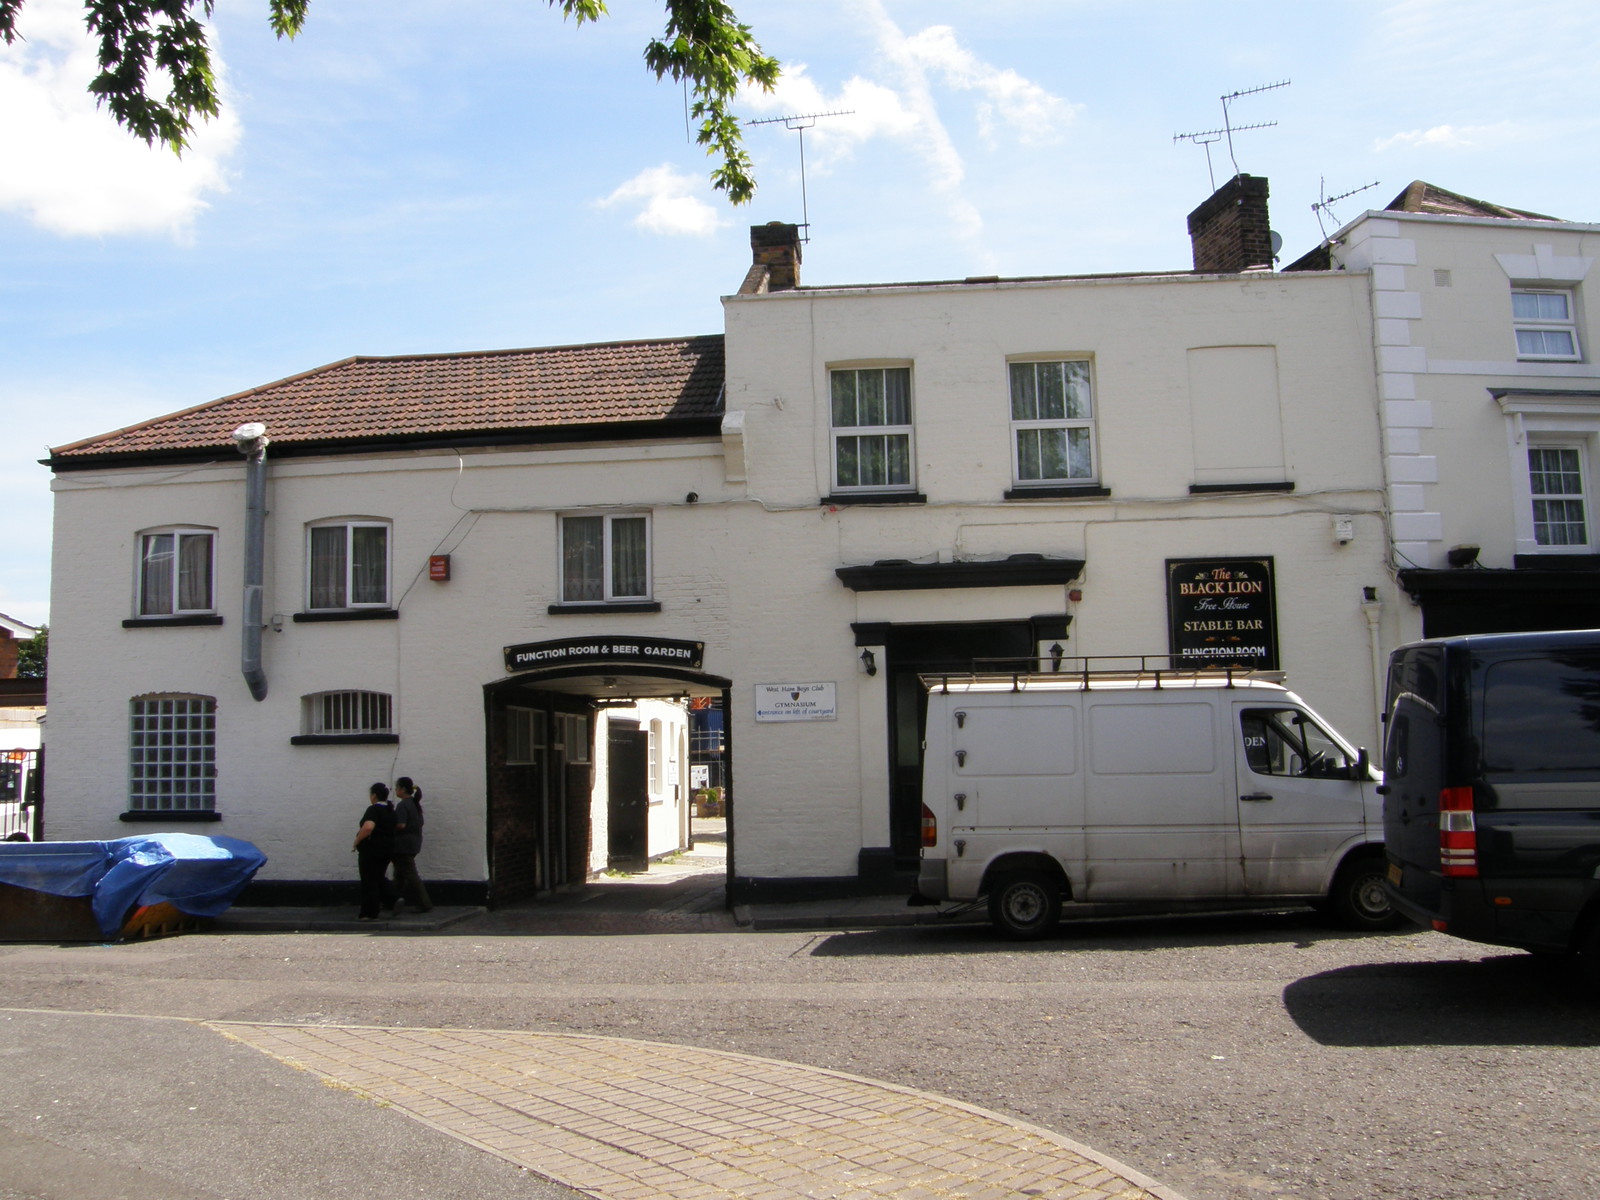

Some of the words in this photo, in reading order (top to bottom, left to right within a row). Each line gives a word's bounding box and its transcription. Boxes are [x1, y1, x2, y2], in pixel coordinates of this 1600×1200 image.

[1211, 567, 1231, 580] The
[1180, 582, 1225, 595] BLACK
[1227, 581, 1263, 593] LION
[1194, 597, 1217, 610] Free
[1218, 597, 1250, 610] House
[1184, 620, 1233, 631] STABLE
[1236, 619, 1264, 630] BAR
[516, 647, 567, 662] FUNCTION
[568, 645, 599, 655] ROOM
[601, 644, 610, 654] &
[612, 644, 639, 655] BEER
[643, 646, 691, 659] GARDEN
[1182, 647, 1234, 659] FUNCTION
[1235, 646, 1266, 657] ROOM
